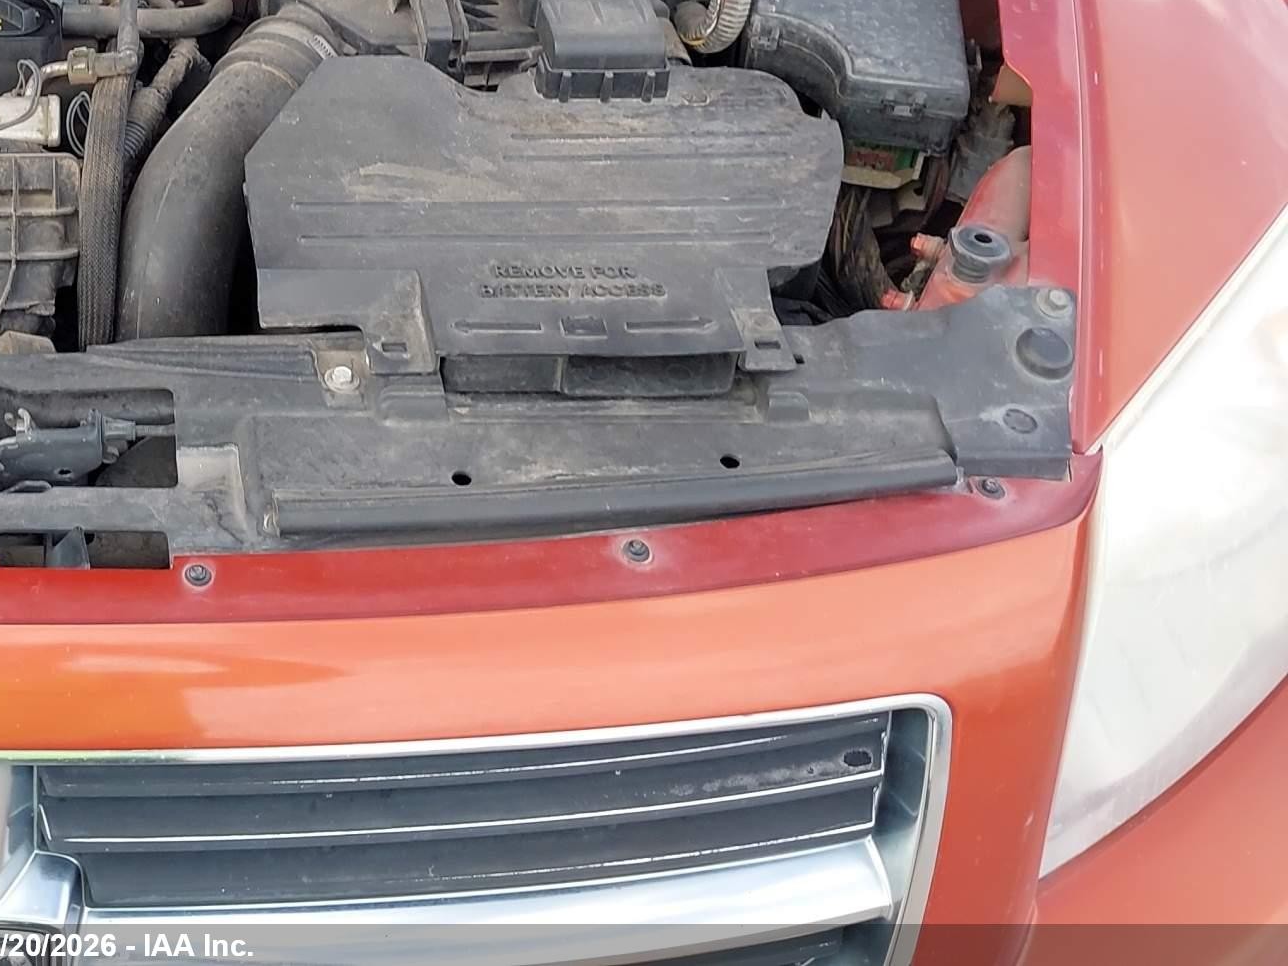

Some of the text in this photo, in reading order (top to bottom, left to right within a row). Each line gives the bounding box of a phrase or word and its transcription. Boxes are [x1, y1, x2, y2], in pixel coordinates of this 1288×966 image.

[495, 265, 636, 279] REMOVE FOR
[481, 282, 667, 298] BATTERY ACCESS
